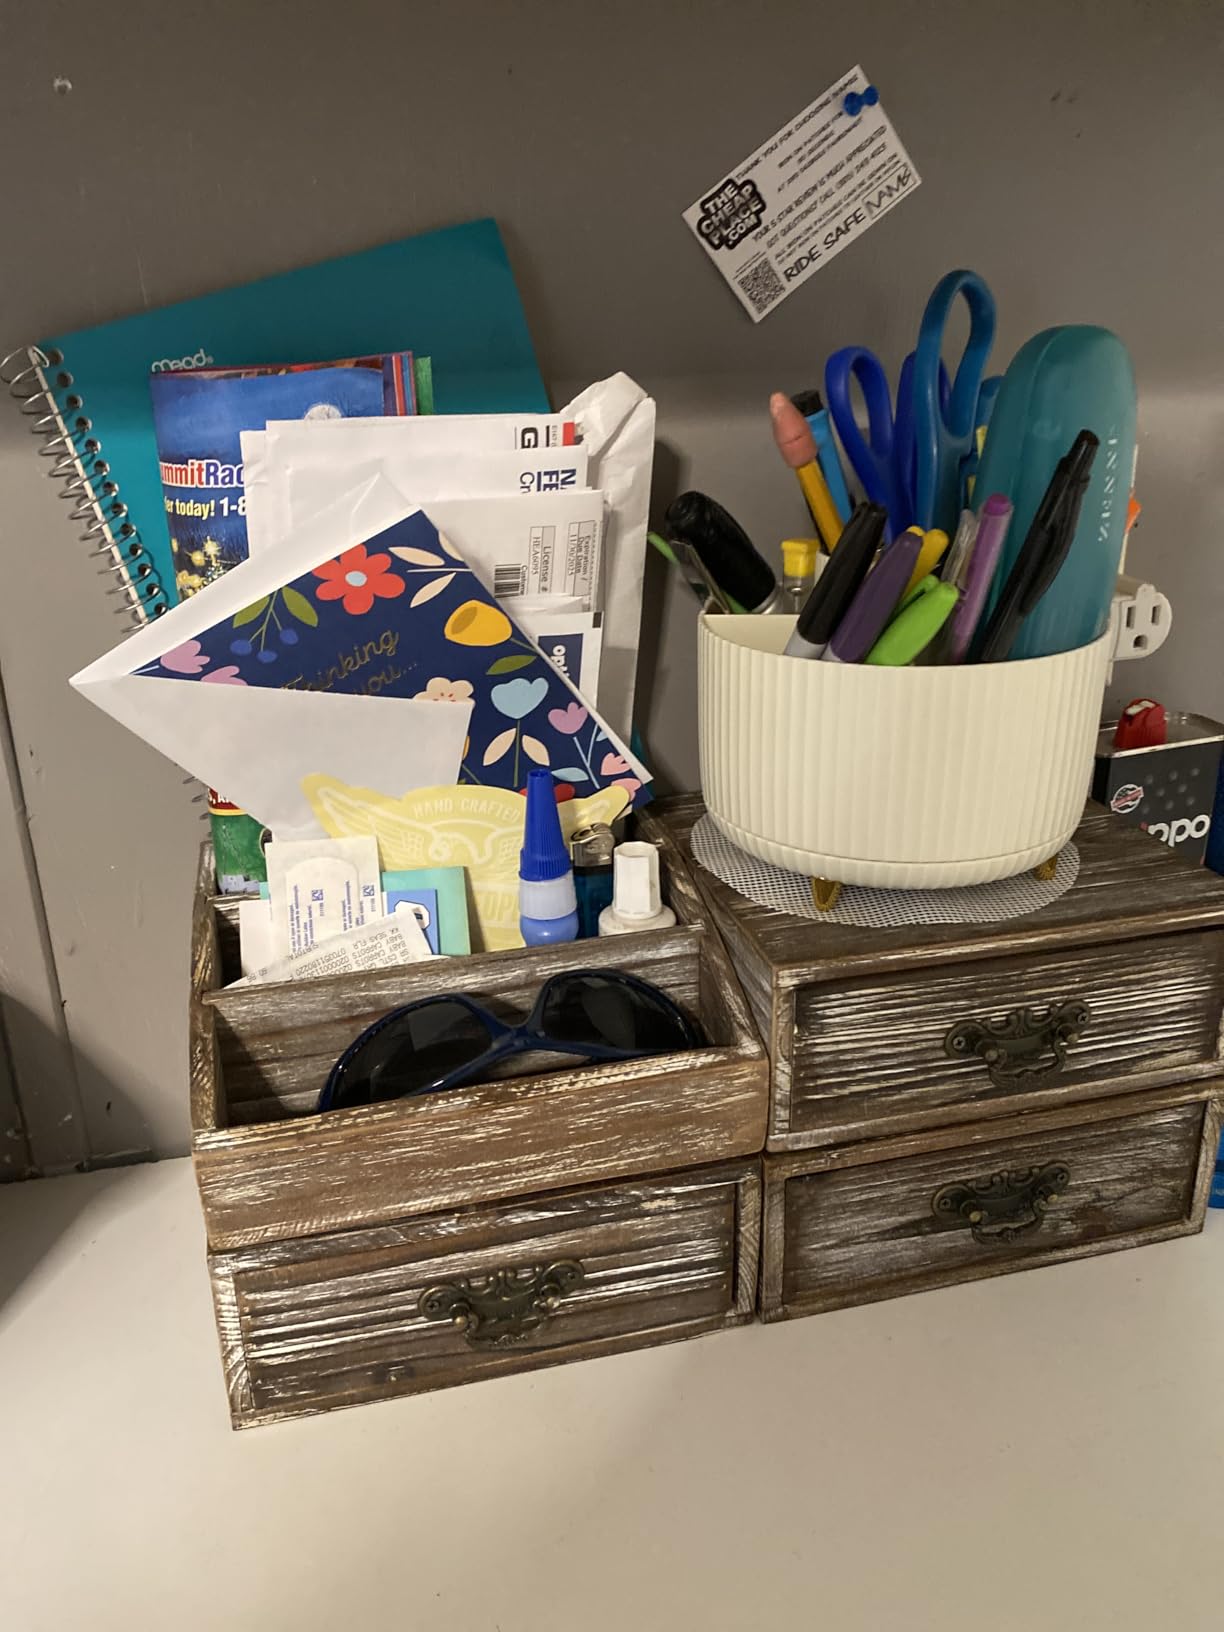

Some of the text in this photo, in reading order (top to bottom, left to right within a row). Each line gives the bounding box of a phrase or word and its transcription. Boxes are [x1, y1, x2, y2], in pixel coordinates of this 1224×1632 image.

[762, 141, 779, 158] YOU
[778, 128, 794, 144] FOR
[698, 183, 756, 236] CHEAP
[703, 182, 738, 216] THE
[707, 194, 761, 245] PLACE
[724, 212, 757, 244] .COM
[752, 223, 771, 242] YOUR
[782, 243, 822, 283] RIDE
[820, 205, 866, 250] SAFE
[151, 349, 206, 373] mead
[560, 469, 577, 490] N
[176, 498, 215, 520] today!
[541, 546, 552, 582] License
[581, 535, 591, 575] Expiration
[550, 644, 569, 678] op
[413, 798, 521, 824] HAND CRAFTED
[352, 944, 382, 959] CARROTS
